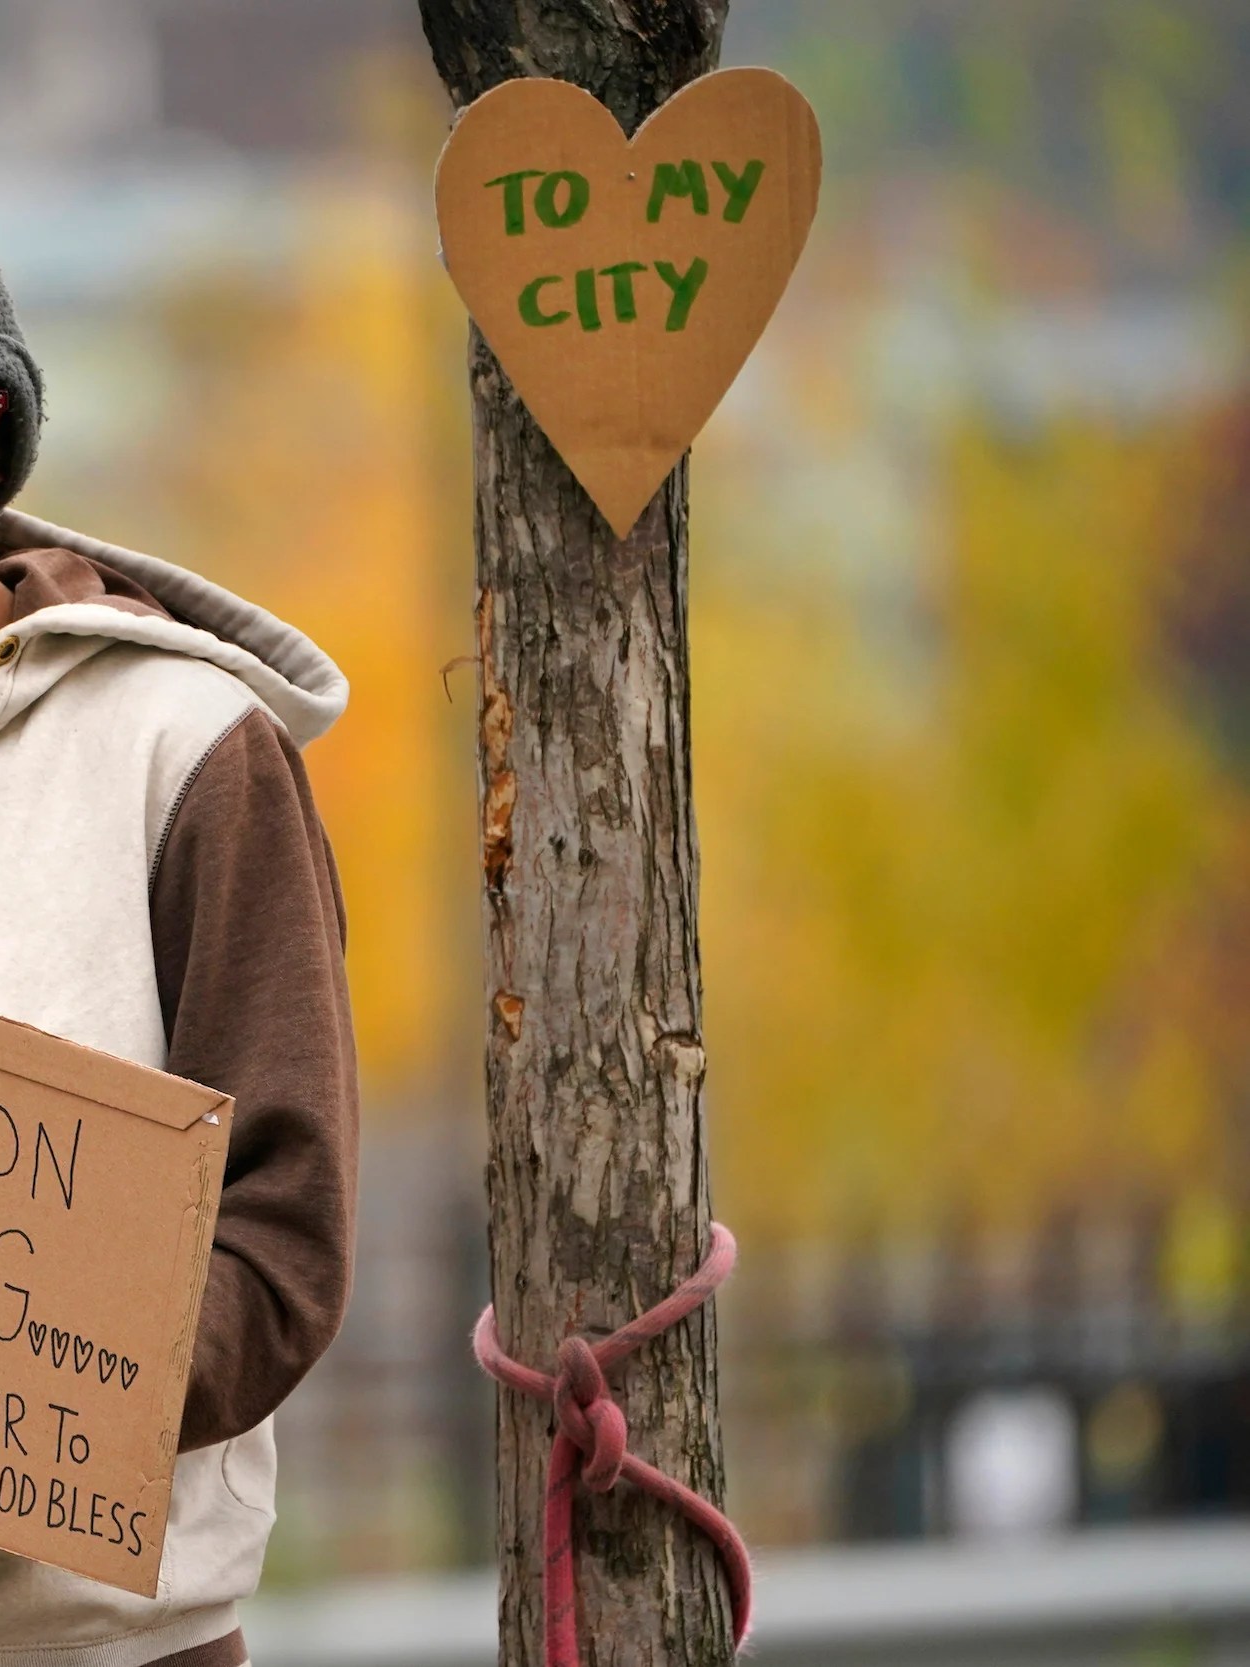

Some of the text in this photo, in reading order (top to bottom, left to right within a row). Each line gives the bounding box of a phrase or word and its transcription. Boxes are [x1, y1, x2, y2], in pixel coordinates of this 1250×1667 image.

[483, 159, 766, 236] TO MY
[517, 256, 709, 332] CITY
[46, 1478, 147, 1556] BLESS
